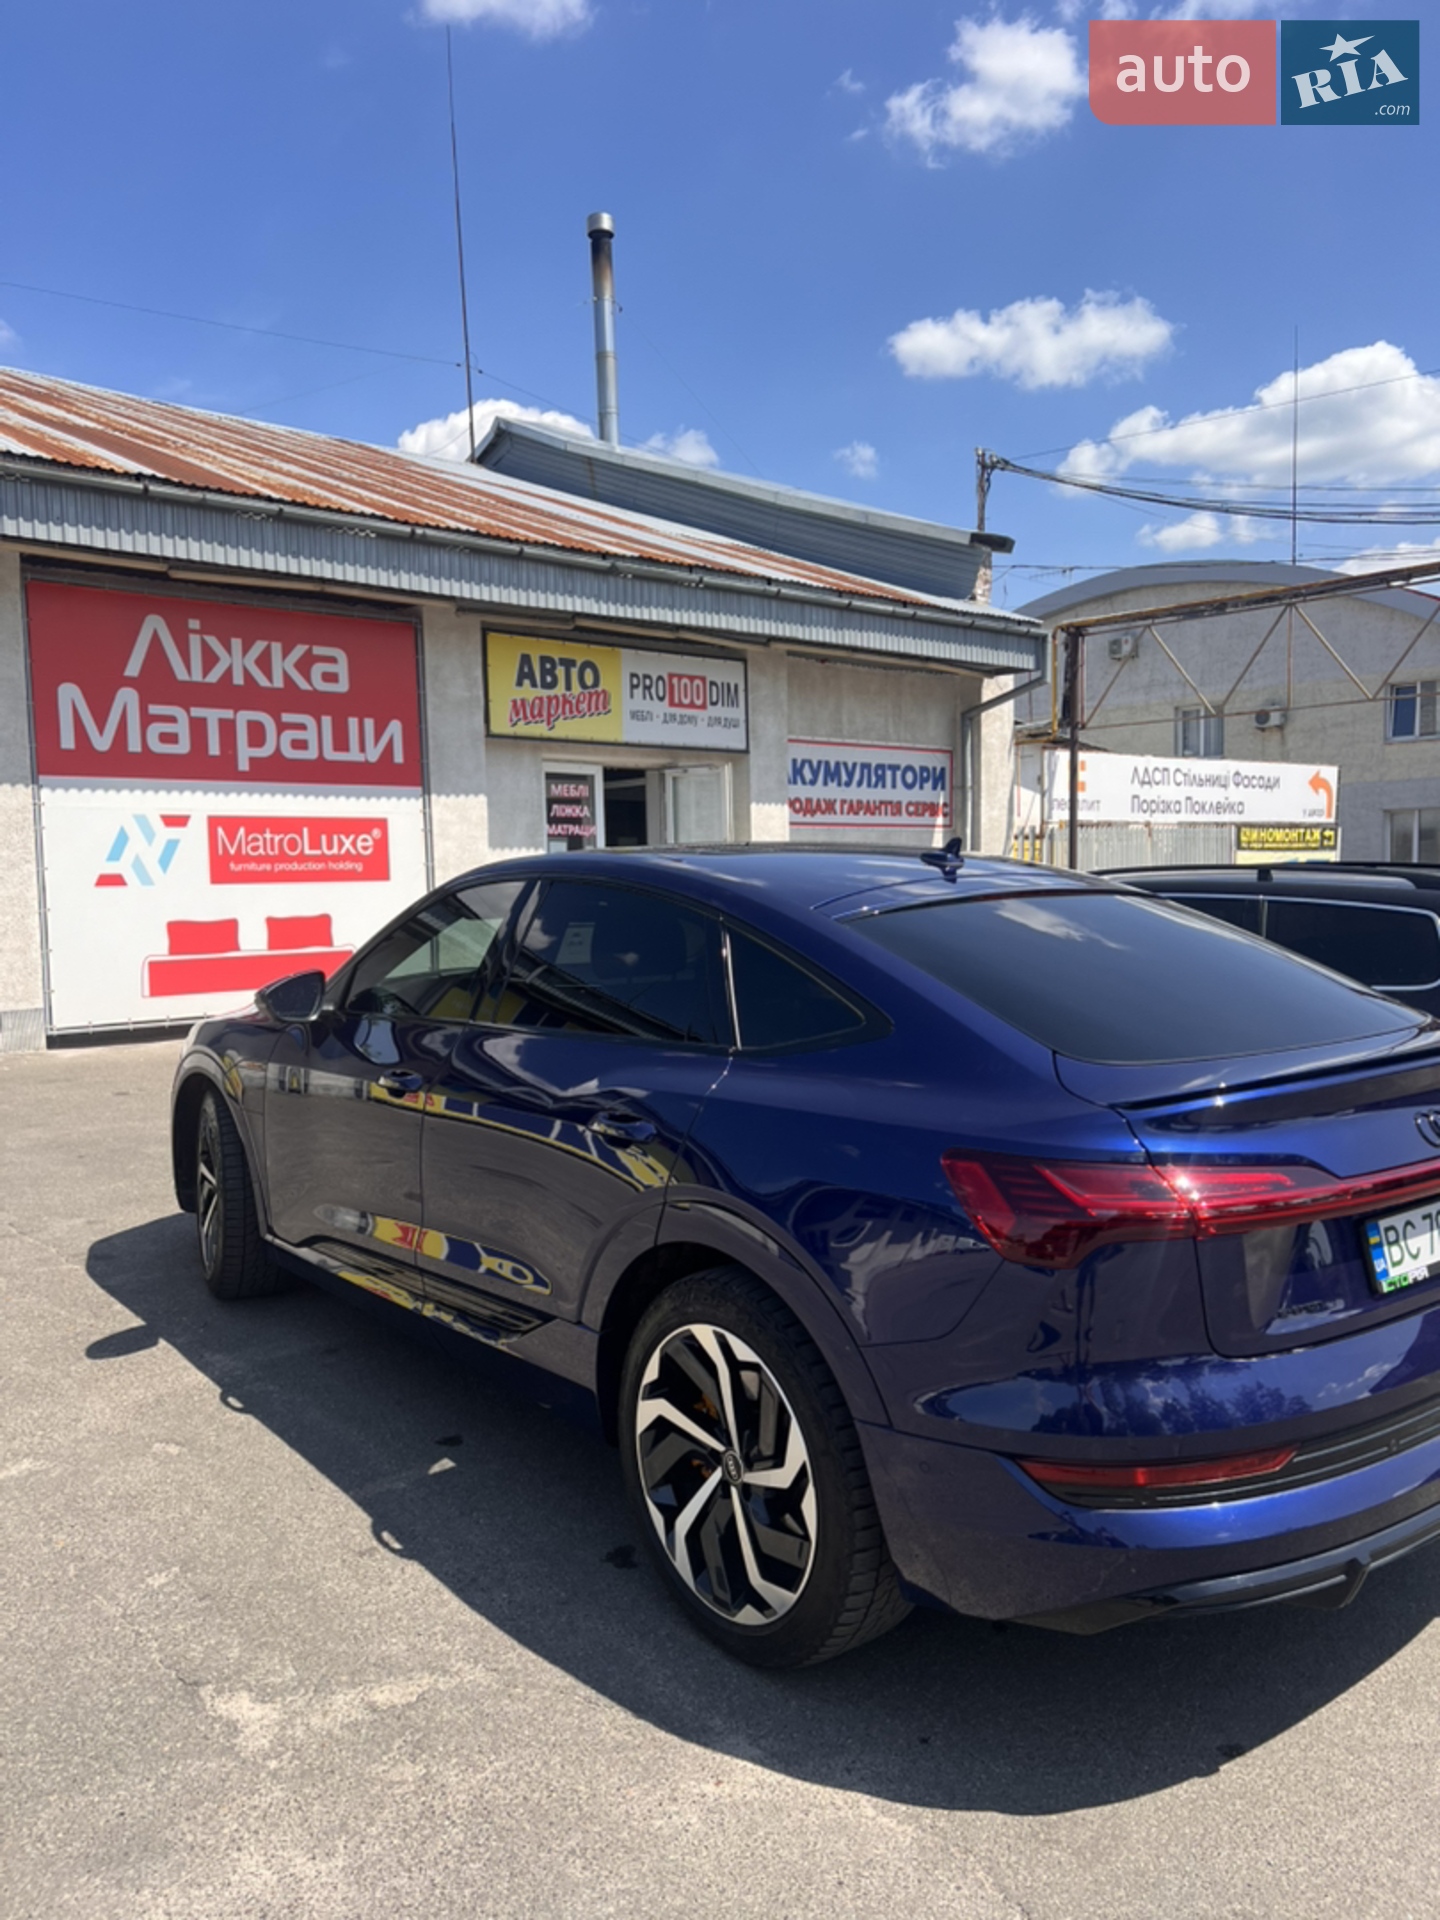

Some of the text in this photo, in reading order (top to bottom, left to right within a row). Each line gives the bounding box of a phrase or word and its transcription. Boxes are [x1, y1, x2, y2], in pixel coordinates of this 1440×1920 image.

[124, 614, 350, 693] Ліжка
[515, 653, 600, 692] АВТО
[509, 688, 611, 730] маркет
[57, 682, 404, 772] Матраци
[550, 784, 589, 797] МЕБЛІ
[1131, 766, 1281, 791] ЛДСП Стільниці Фасади
[1131, 794, 1245, 817] Порізка Поклейка
[229, 859, 363, 874] furniture production holding
